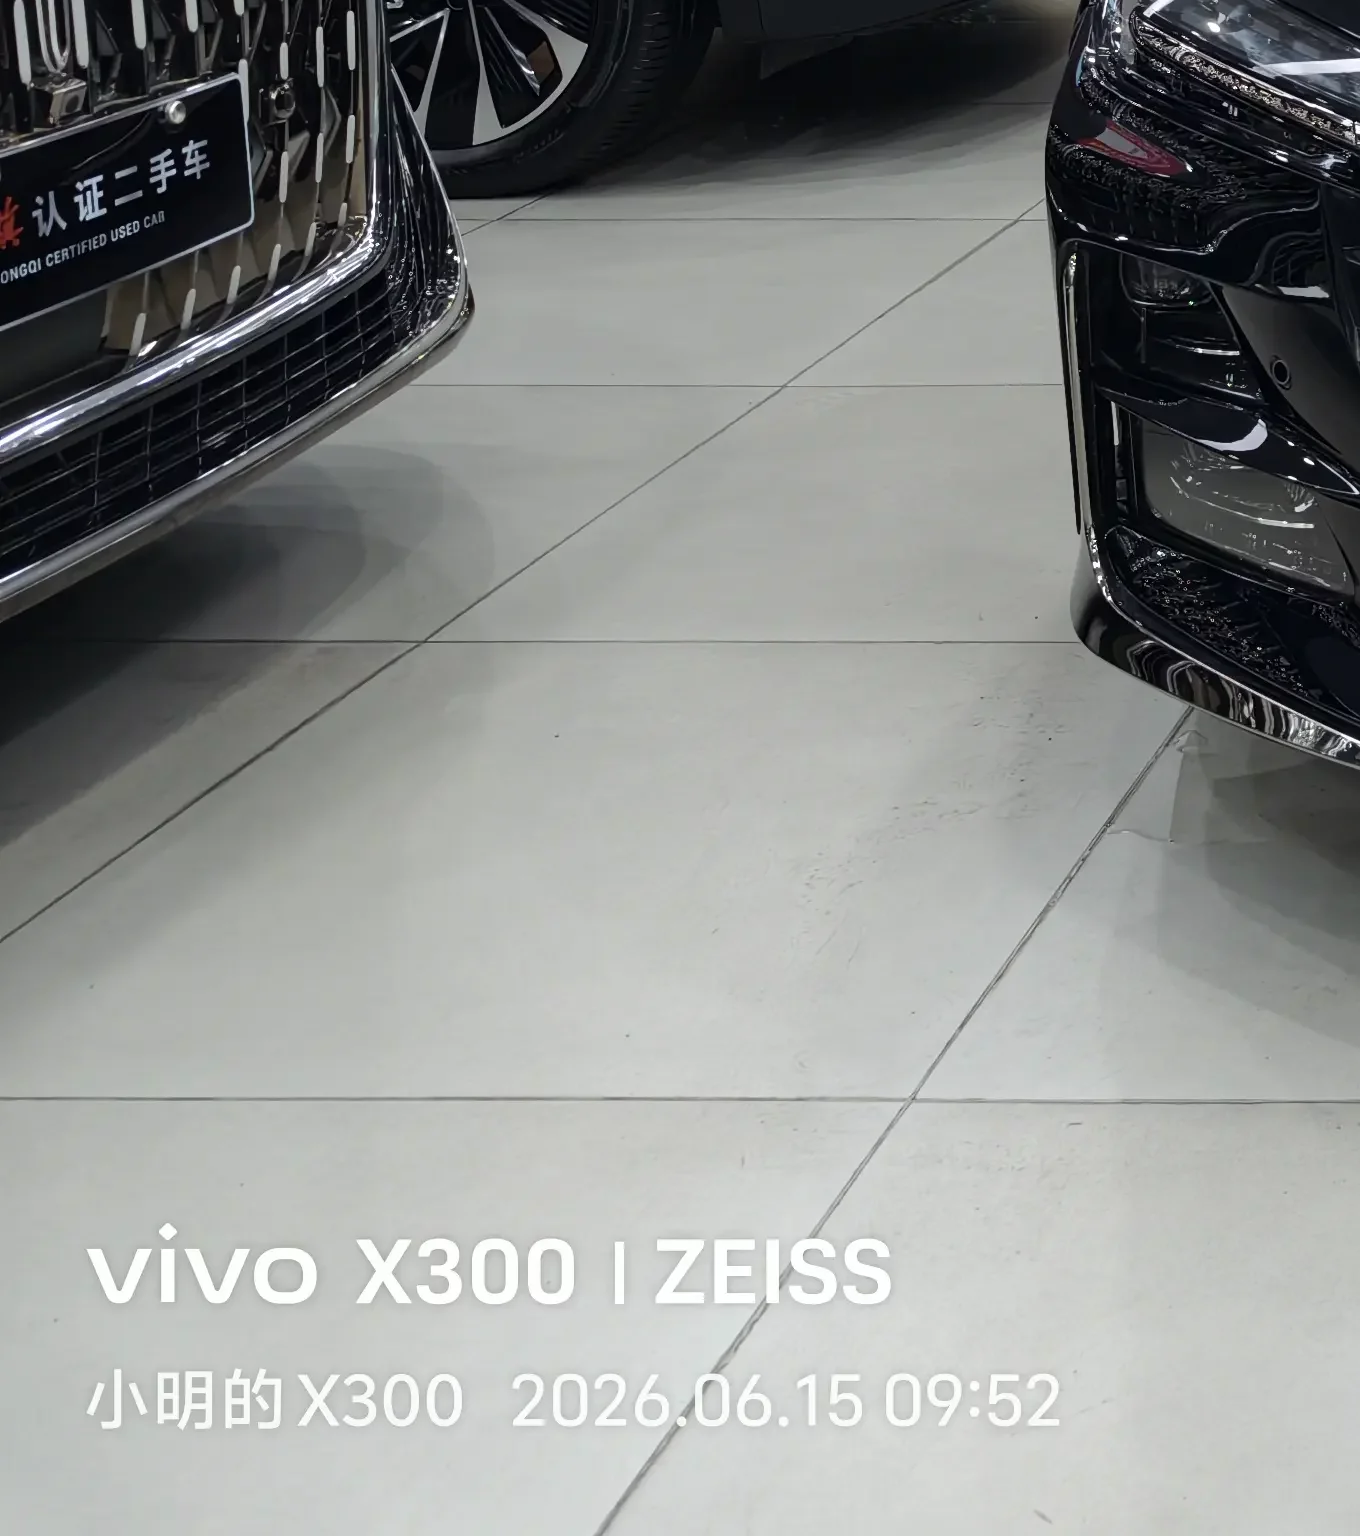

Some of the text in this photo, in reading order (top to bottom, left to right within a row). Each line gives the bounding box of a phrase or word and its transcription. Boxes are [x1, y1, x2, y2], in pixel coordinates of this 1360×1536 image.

[0, 210, 166, 284] ONGQI CERTIFIED USED CAR
